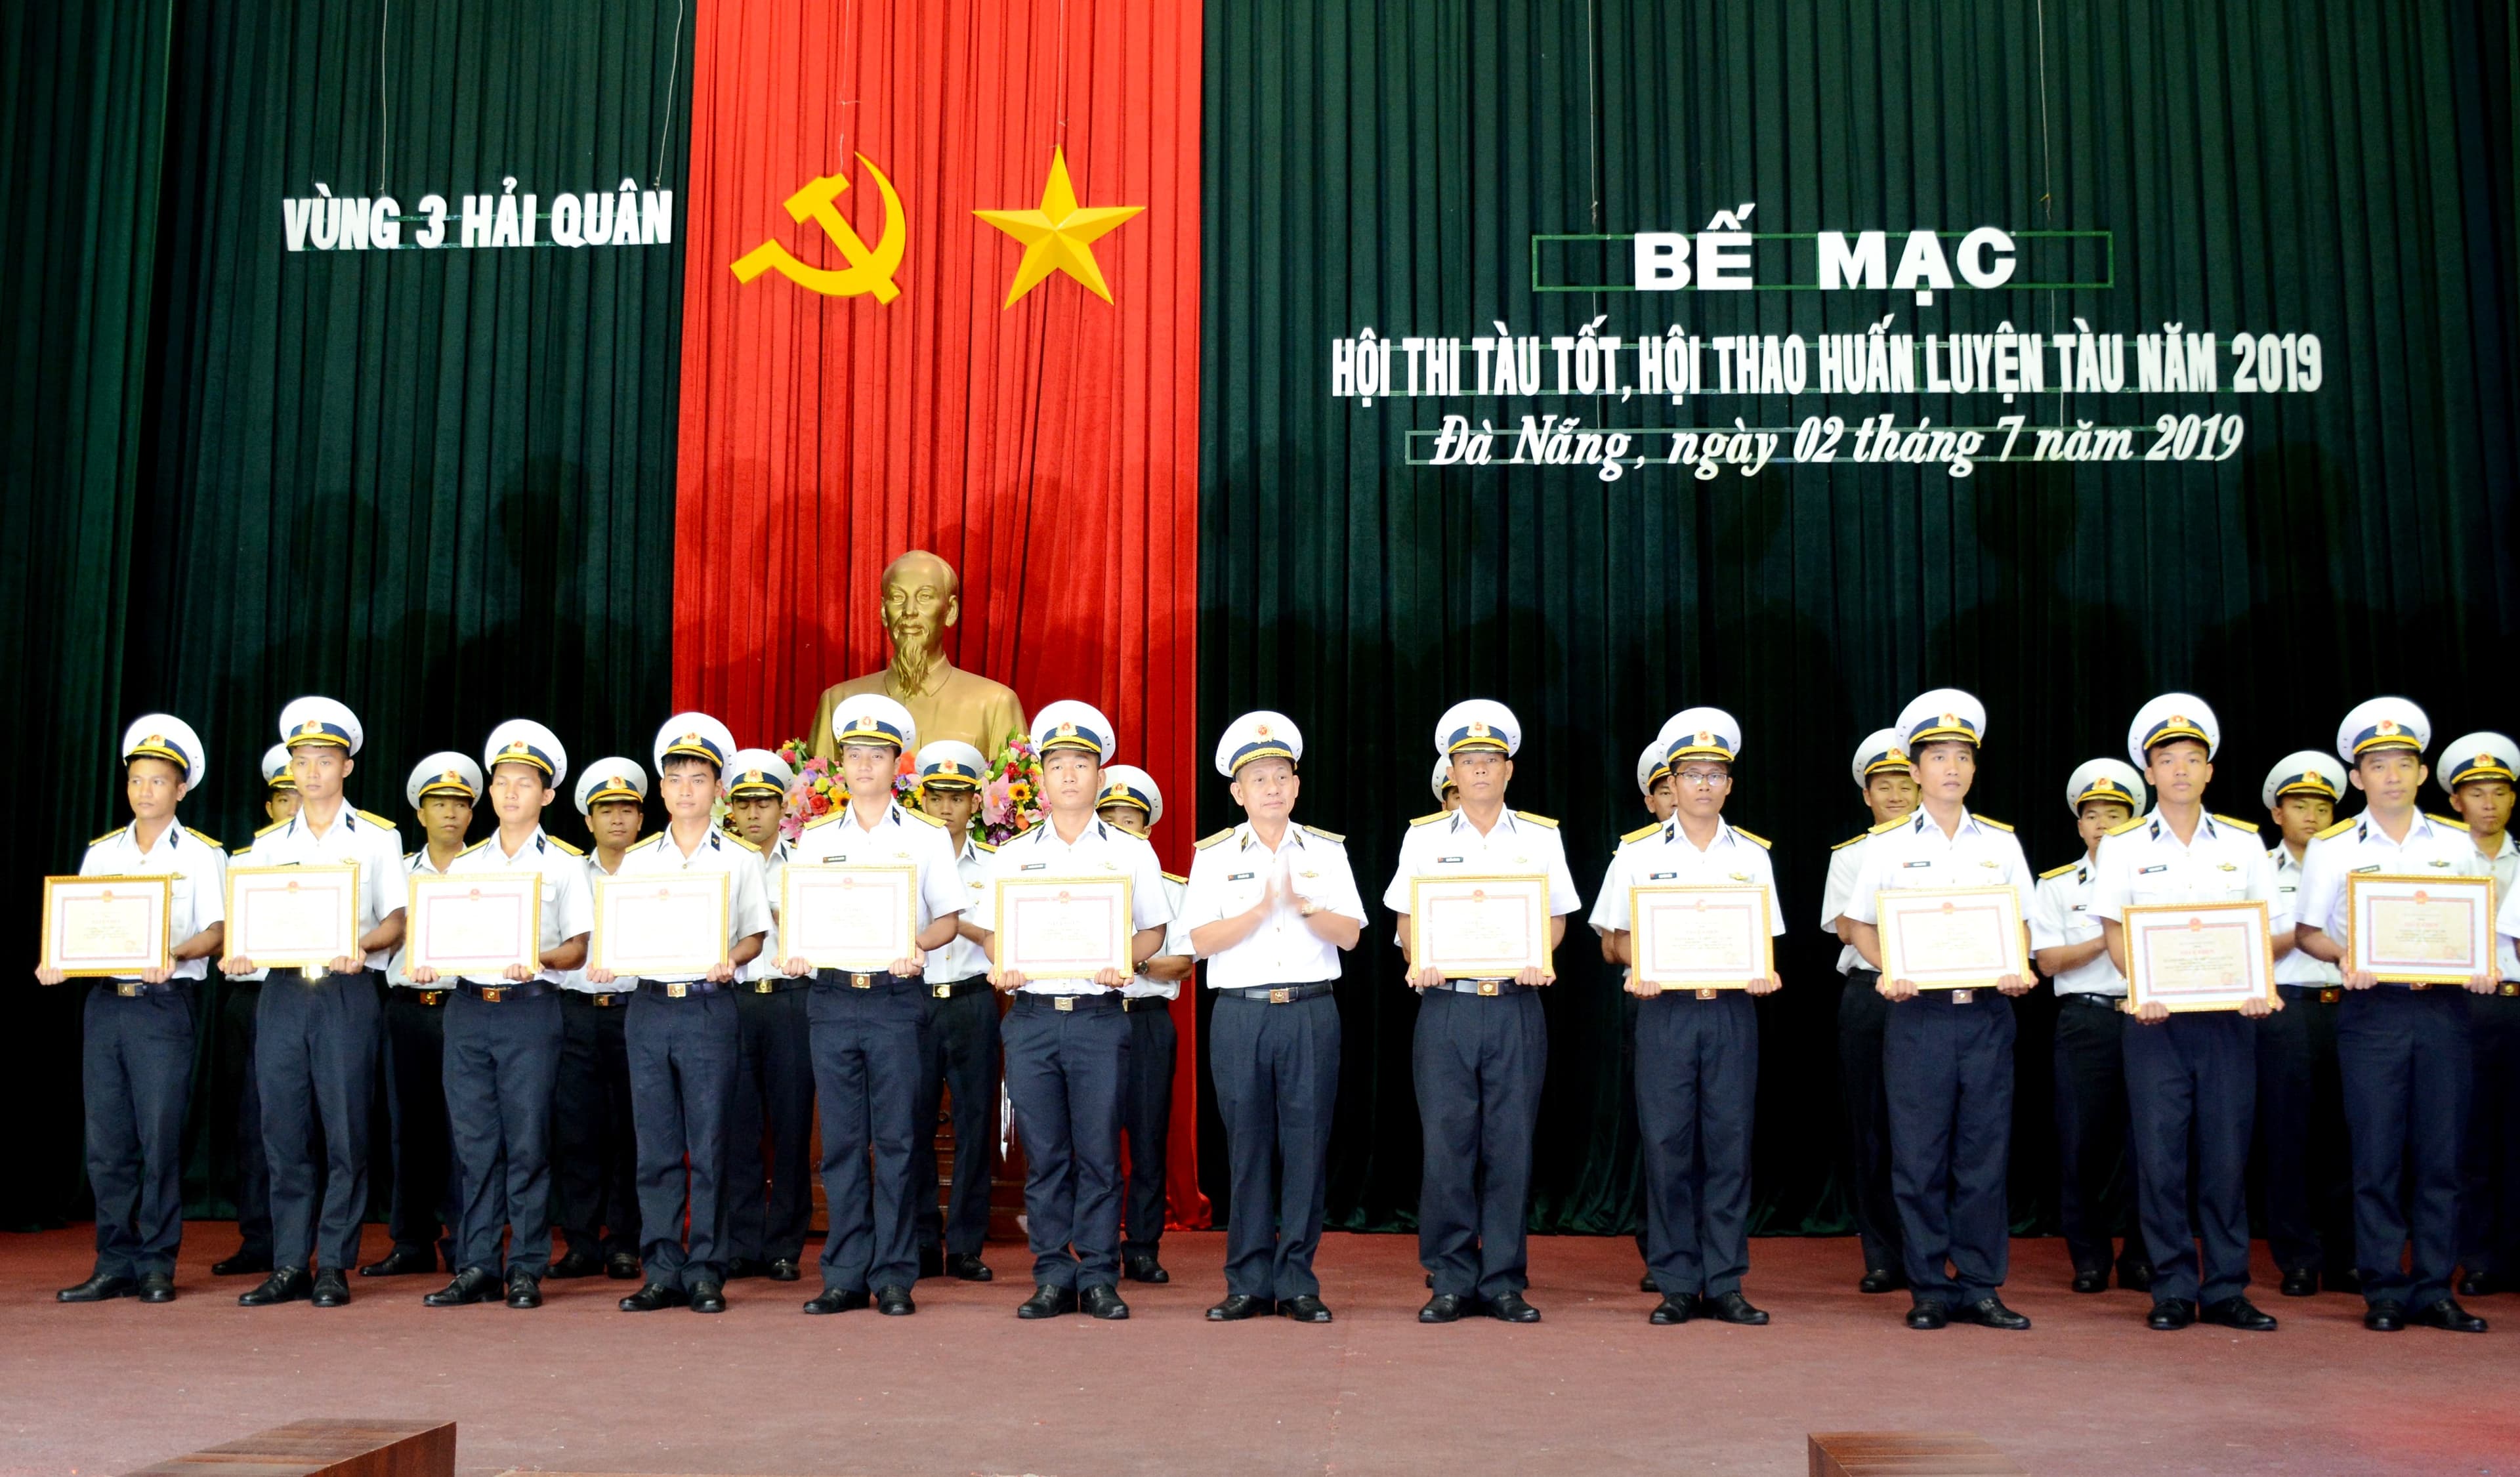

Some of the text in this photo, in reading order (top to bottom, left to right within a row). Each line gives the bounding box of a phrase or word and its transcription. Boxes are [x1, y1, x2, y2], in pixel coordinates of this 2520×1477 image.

[283, 176, 673, 251] VÙNG 3 HẢI QUÂN
[1634, 203, 2016, 306] BẾ MẠC
[1332, 313, 2322, 407] HỘI THI TÀU TỐT, HỘI THAO HUẤN LUYỆN TÀU NĂM 2019
[1428, 415, 1494, 465] Đà
[1667, 417, 1778, 480] ngày
[1793, 416, 1845, 463] 02
[1853, 413, 1985, 478] tháng
[1996, 415, 2025, 462] 7
[2032, 419, 2133, 461] năm
[2145, 413, 2244, 461] 2019
